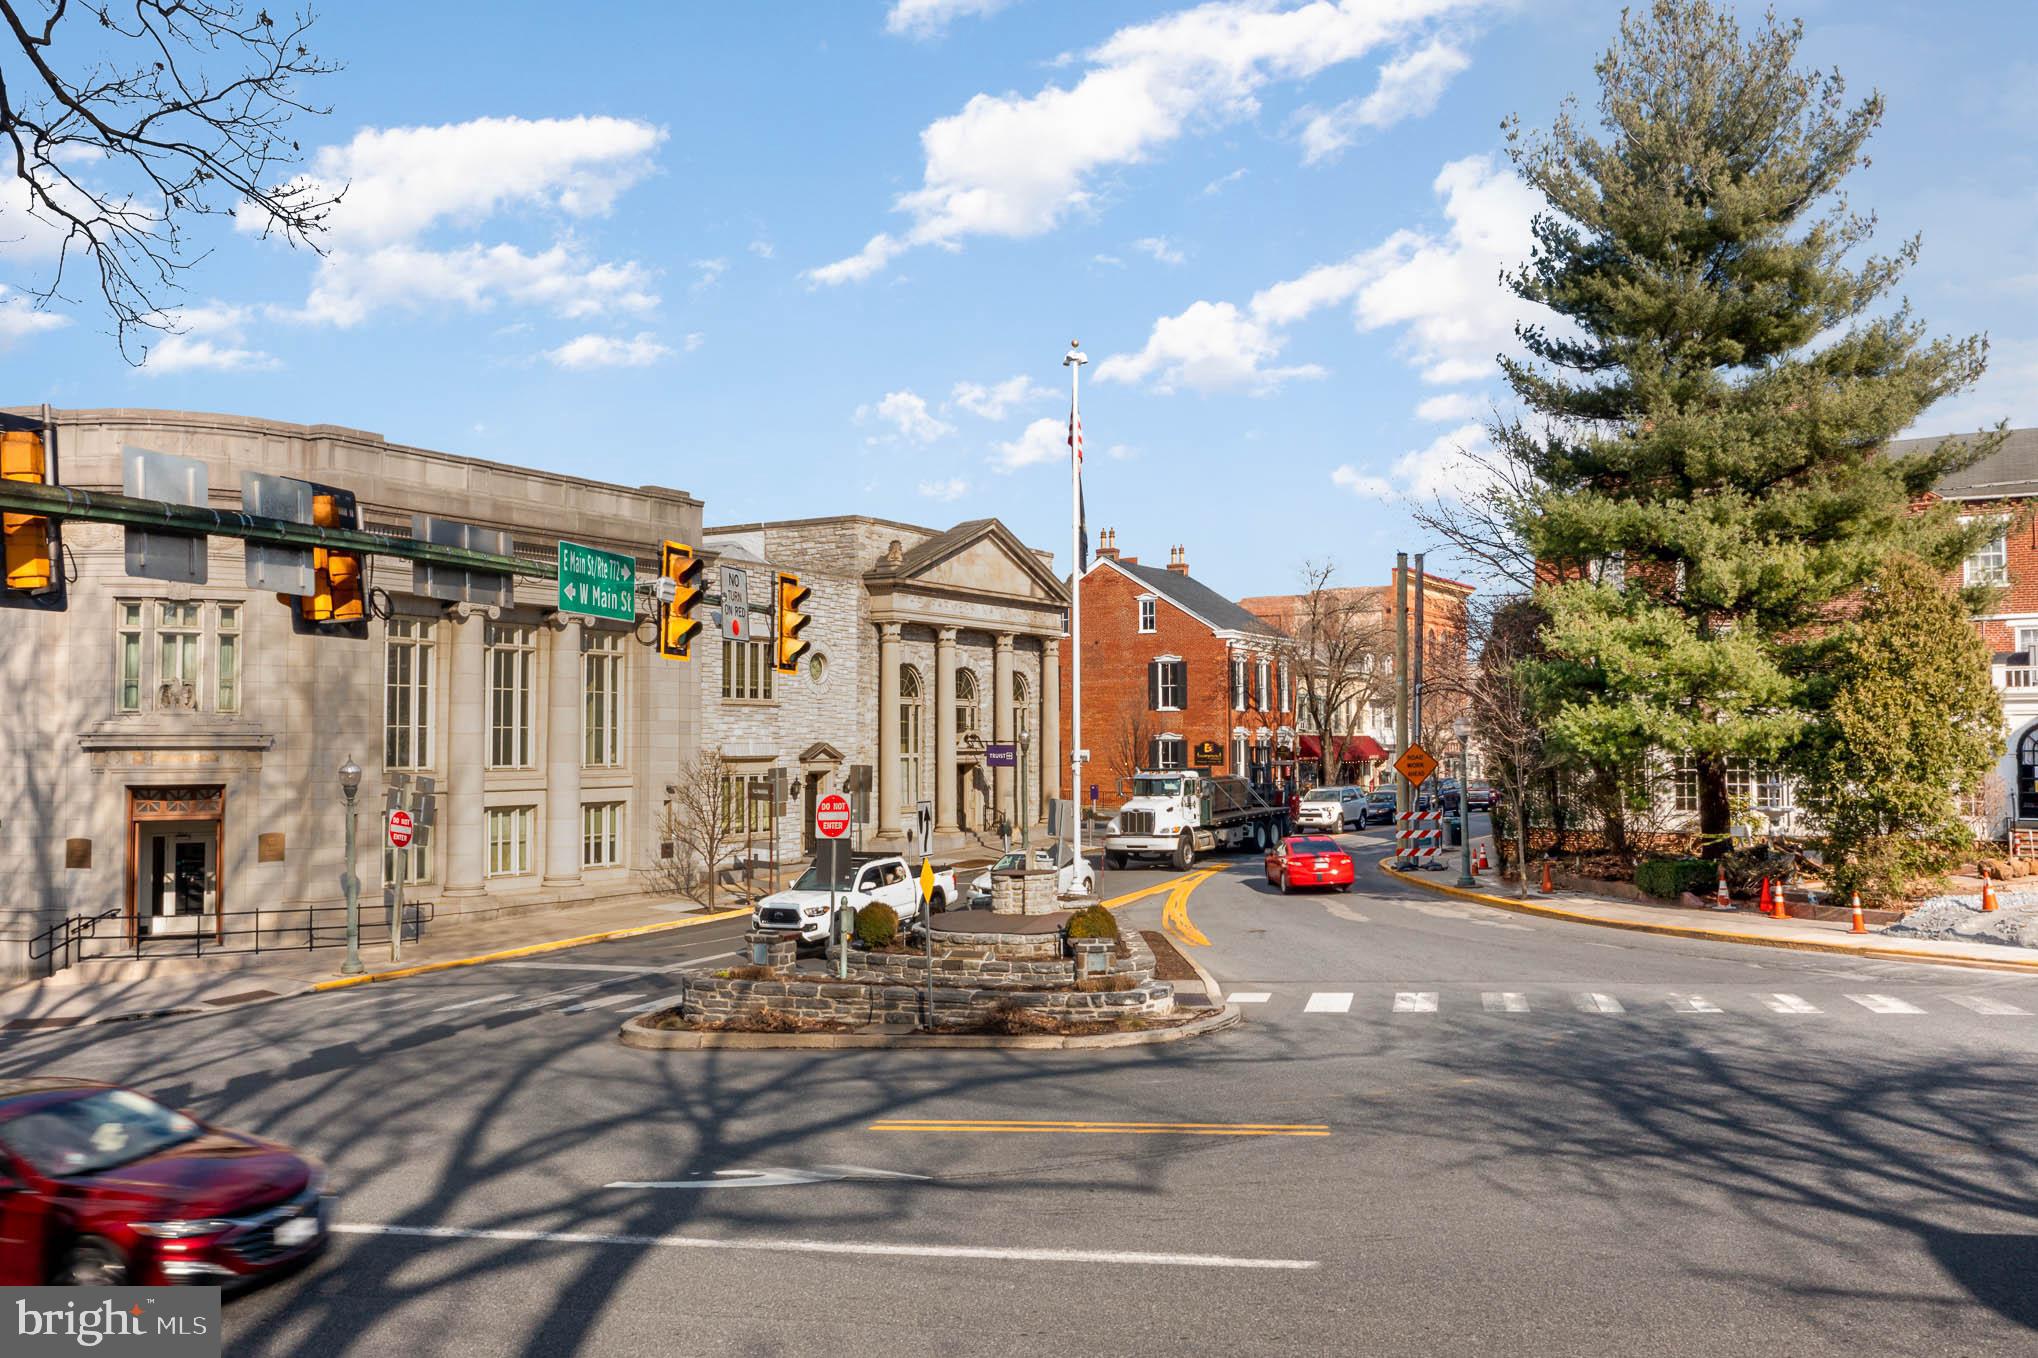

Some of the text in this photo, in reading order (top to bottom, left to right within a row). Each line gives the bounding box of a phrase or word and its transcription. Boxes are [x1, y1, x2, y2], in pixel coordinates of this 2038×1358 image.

[563, 549, 620, 581] E Main St/Rte 772
[728, 572, 740, 587] NO
[579, 582, 632, 612] W Main St
[728, 590, 742, 602] TURN
[725, 604, 746, 617] ON RED
[821, 802, 846, 811] DO NOT
[392, 816, 410, 826] DO NOT
[823, 821, 843, 830] ENTER
